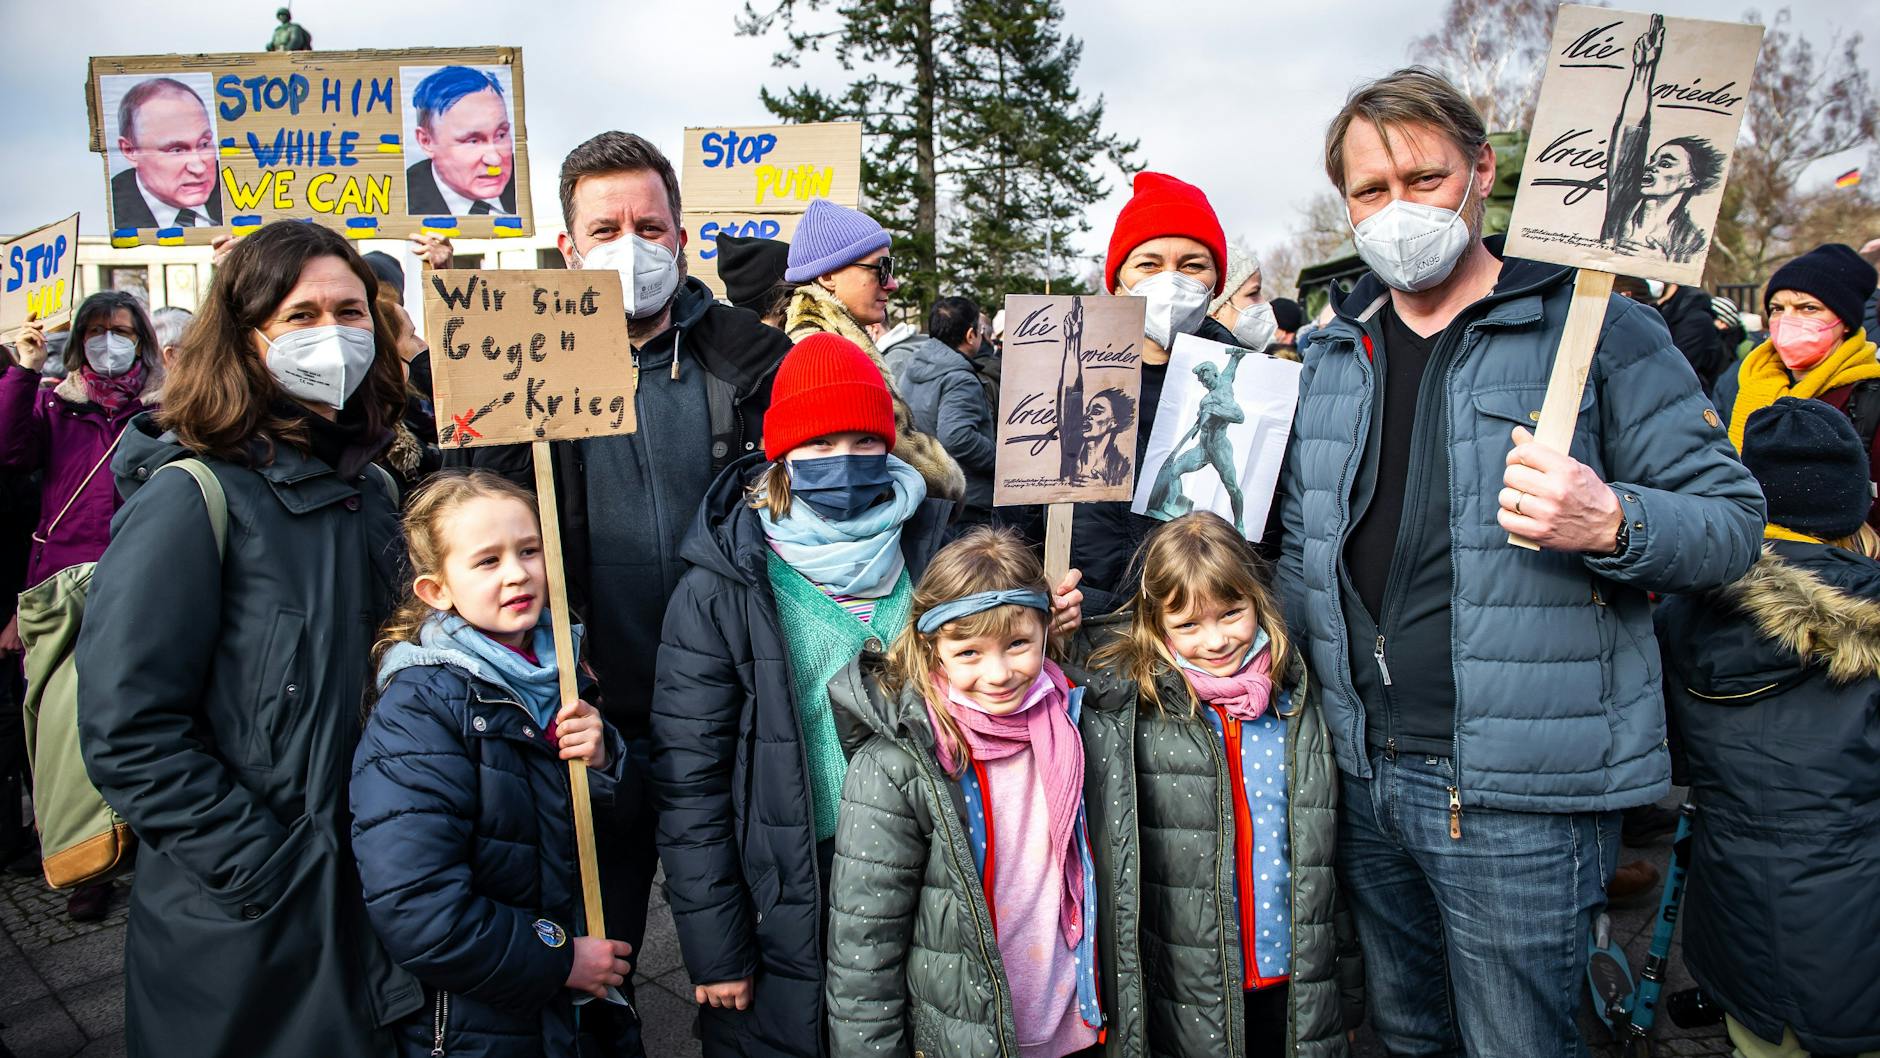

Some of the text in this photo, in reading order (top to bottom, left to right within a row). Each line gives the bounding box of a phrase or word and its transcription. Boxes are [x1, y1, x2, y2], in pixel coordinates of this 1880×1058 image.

[1560, 21, 1625, 59] Nie
[216, 73, 393, 121] STOP HIM
[1651, 78, 1742, 107] wieder
[247, 127, 360, 168] WHILE
[222, 166, 392, 215] WE CAN
[6, 234, 67, 293] STOP
[1416, 254, 1441, 272] KN95
[27, 278, 65, 320] WAR
[432, 274, 507, 312] Wir
[1013, 303, 1058, 338] Nie
[443, 317, 575, 381] Gegen
[1081, 343, 1141, 363] wieder
[525, 377, 625, 429] Krieg
